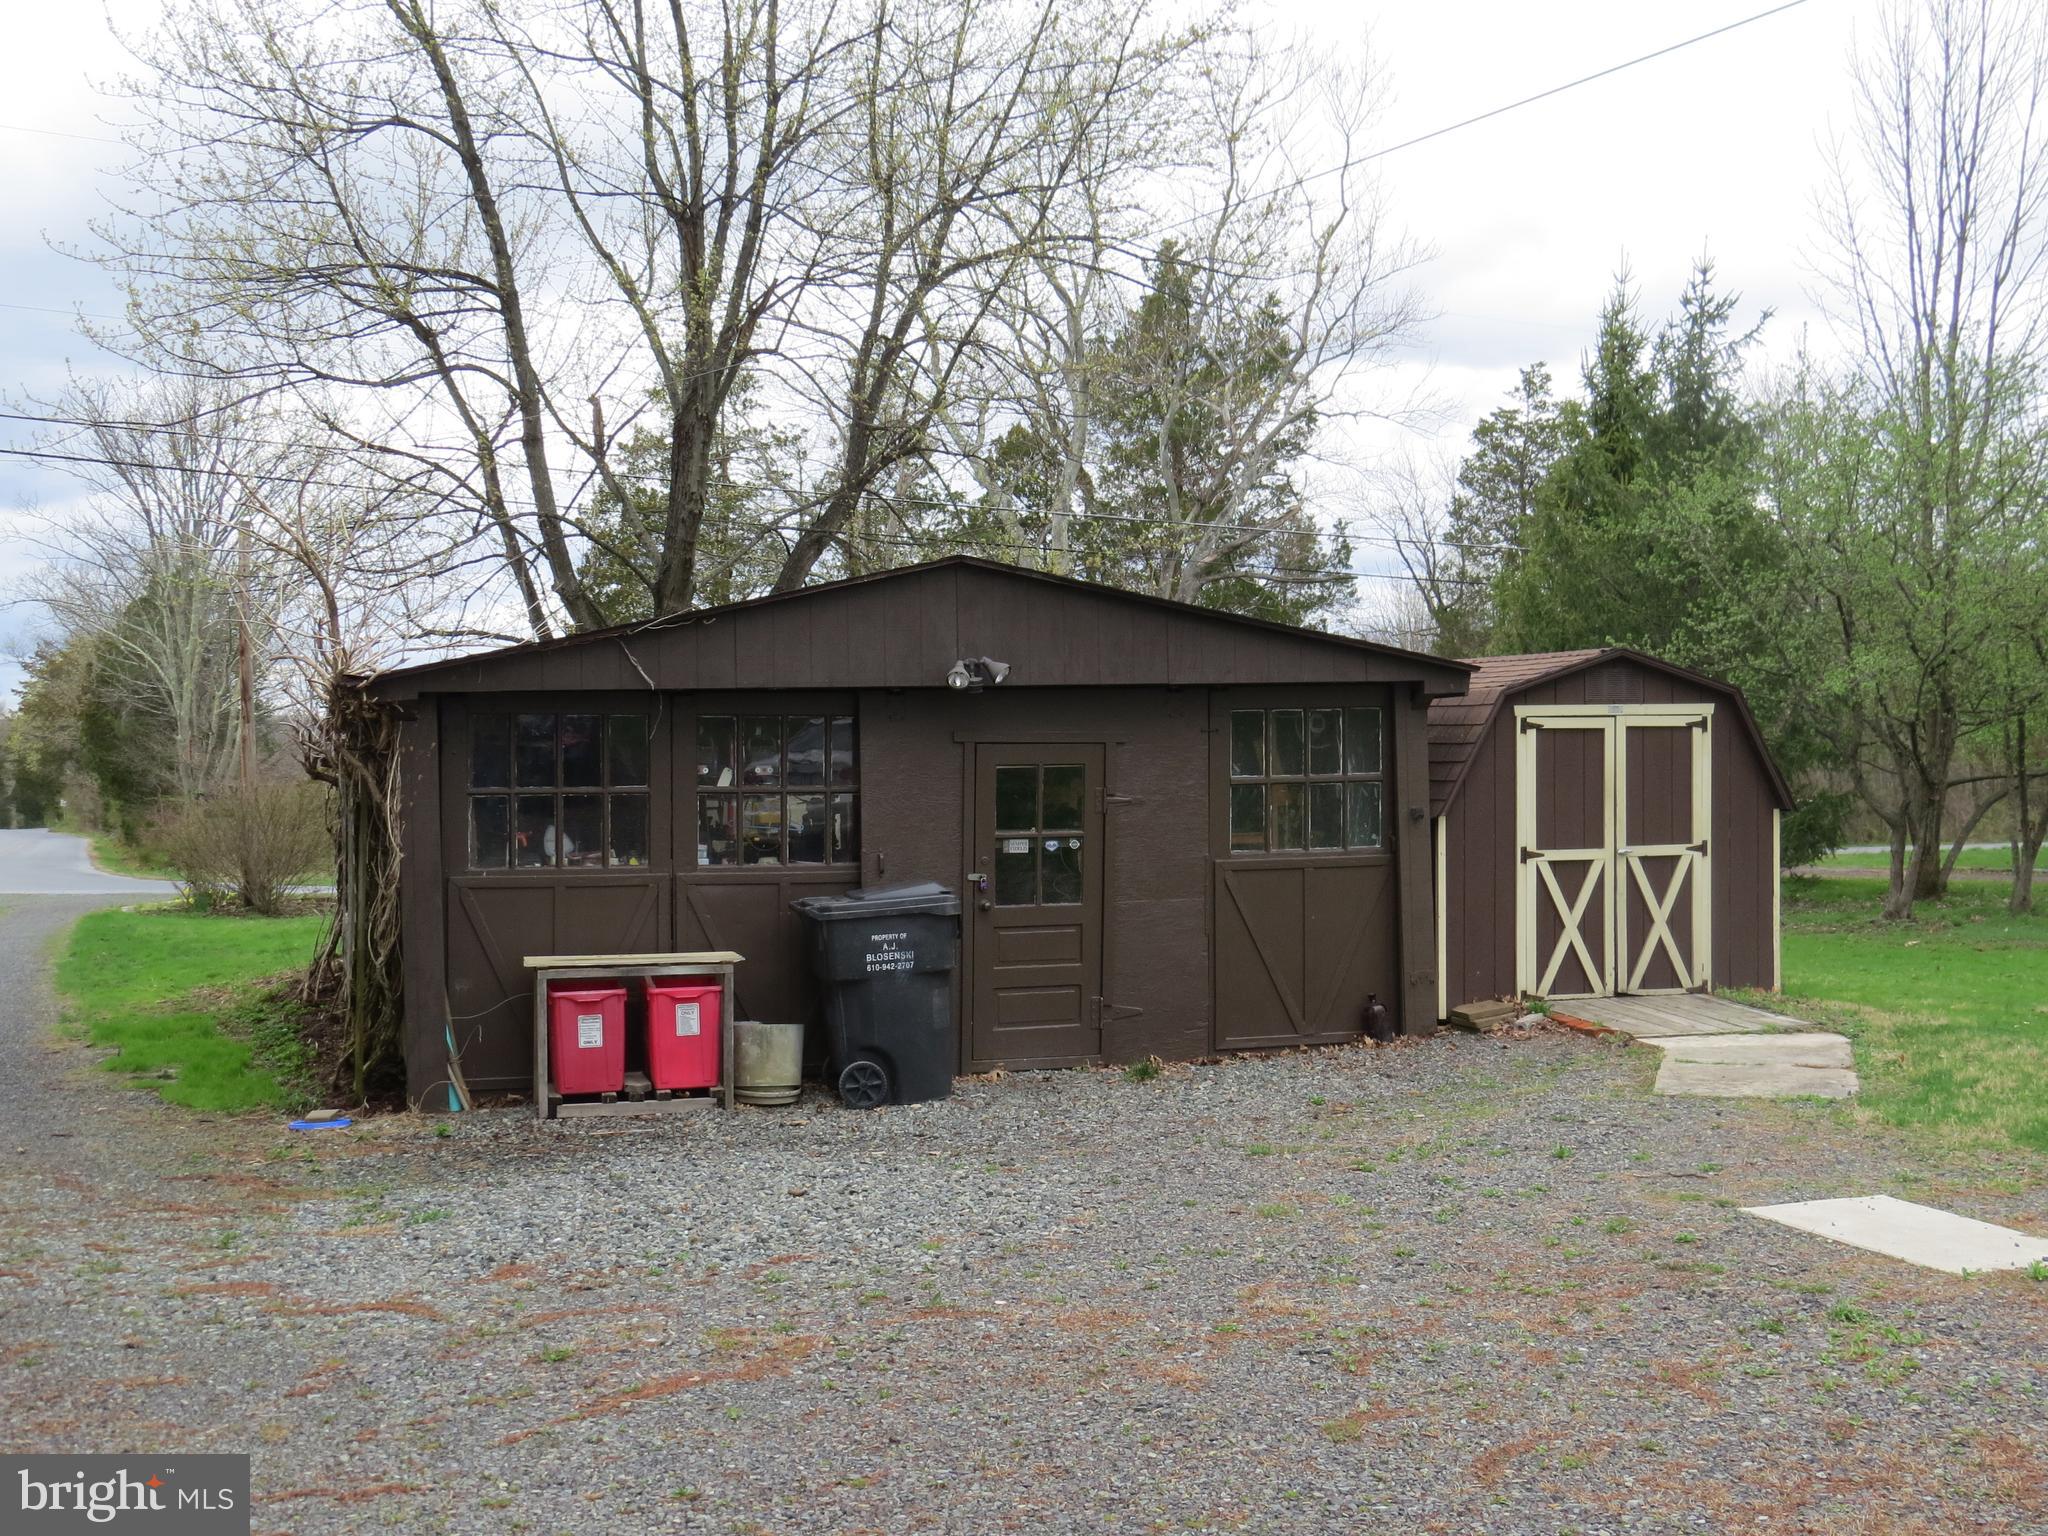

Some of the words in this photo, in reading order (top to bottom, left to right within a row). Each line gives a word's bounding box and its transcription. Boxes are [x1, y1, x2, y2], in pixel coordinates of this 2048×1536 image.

[871, 933, 899, 941] PROPERTY
[899, 932, 907, 940] OF
[882, 942, 898, 950] A.J.
[866, 950, 914, 961] BLOSENSKI
[866, 961, 914, 971] 610-942-2707
